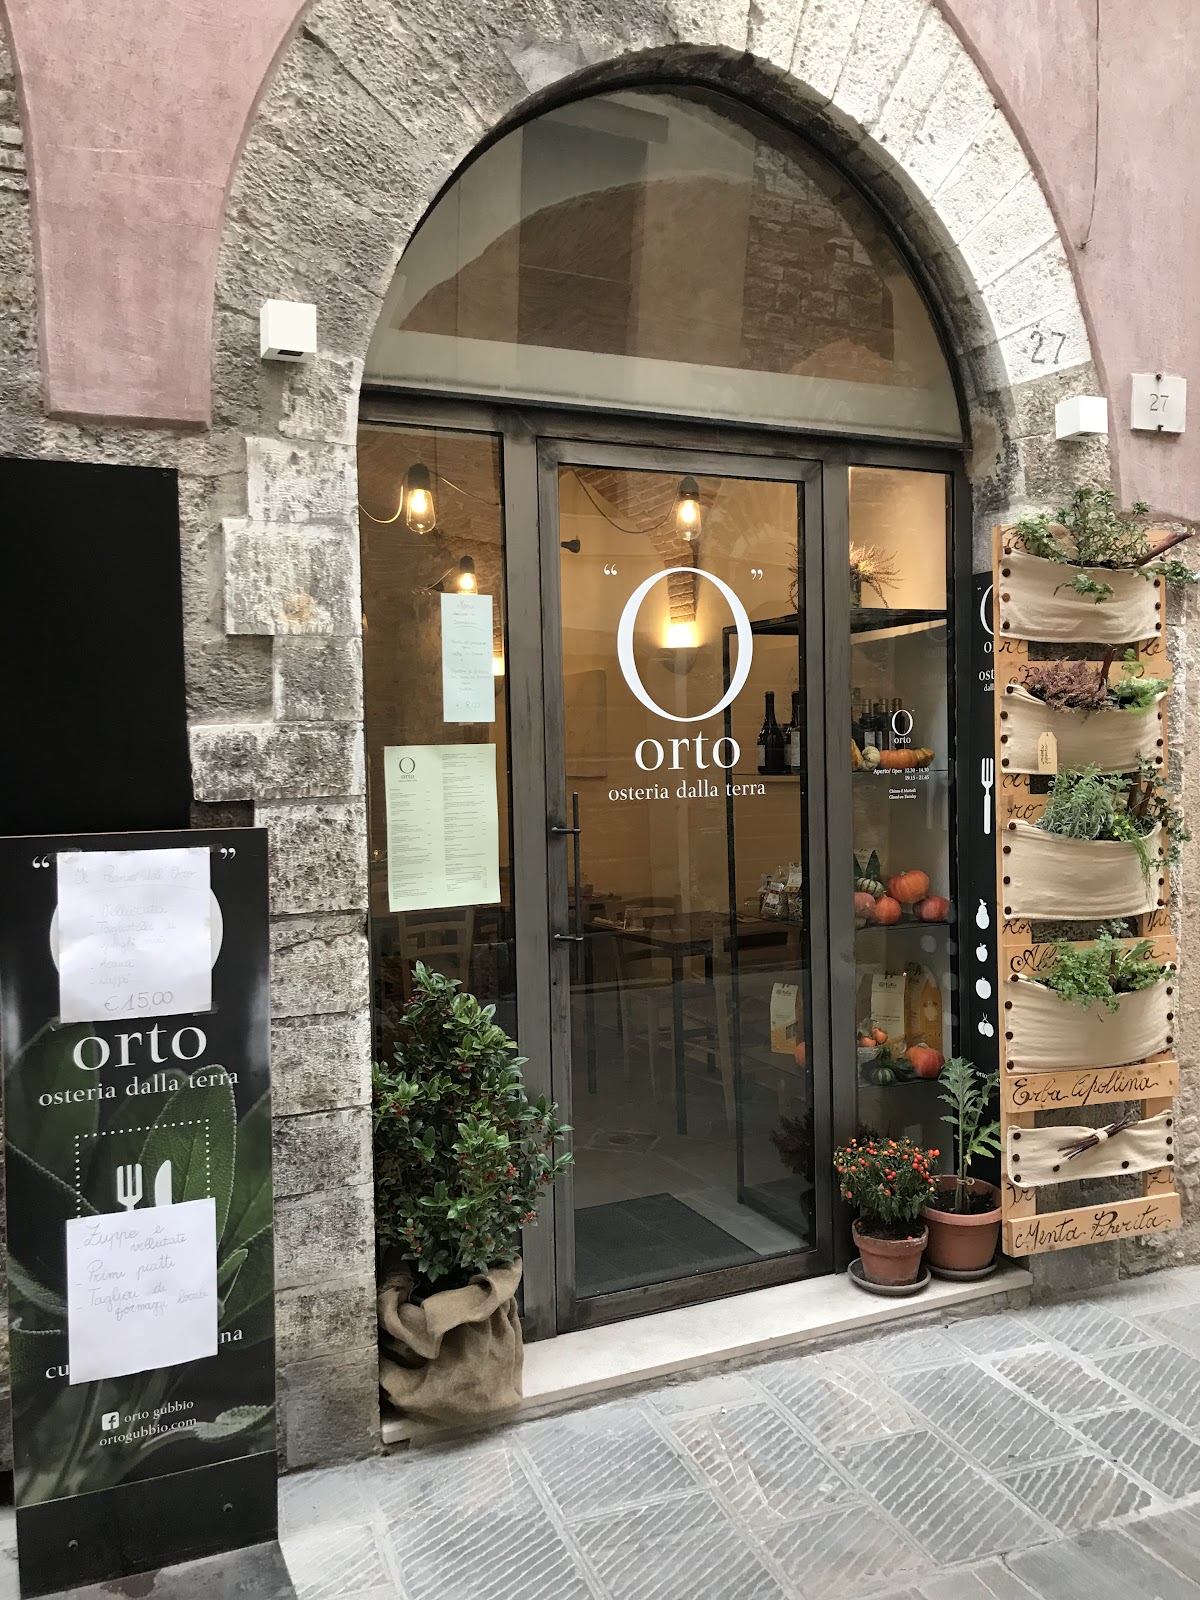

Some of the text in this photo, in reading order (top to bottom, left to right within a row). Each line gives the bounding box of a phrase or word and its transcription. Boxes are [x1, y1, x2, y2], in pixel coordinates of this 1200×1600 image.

[1030, 330, 1067, 365] 27
[1149, 393, 1170, 412] 27
[634, 730, 741, 771] orto
[893, 736, 912, 744] orto
[608, 779, 767, 801] osteria dalla terra
[73, 1022, 207, 1071] orto
[38, 1071, 240, 1107] osteria dalla terra
[1012, 1079, 1069, 1106] Erba
[84, 1222, 139, 1250] Zuppe
[1014, 1204, 1172, 1250] Menta Piperita
[124, 1400, 194, 1423] orto gubbio
[99, 1416, 197, 1447] ortogubbio.com
